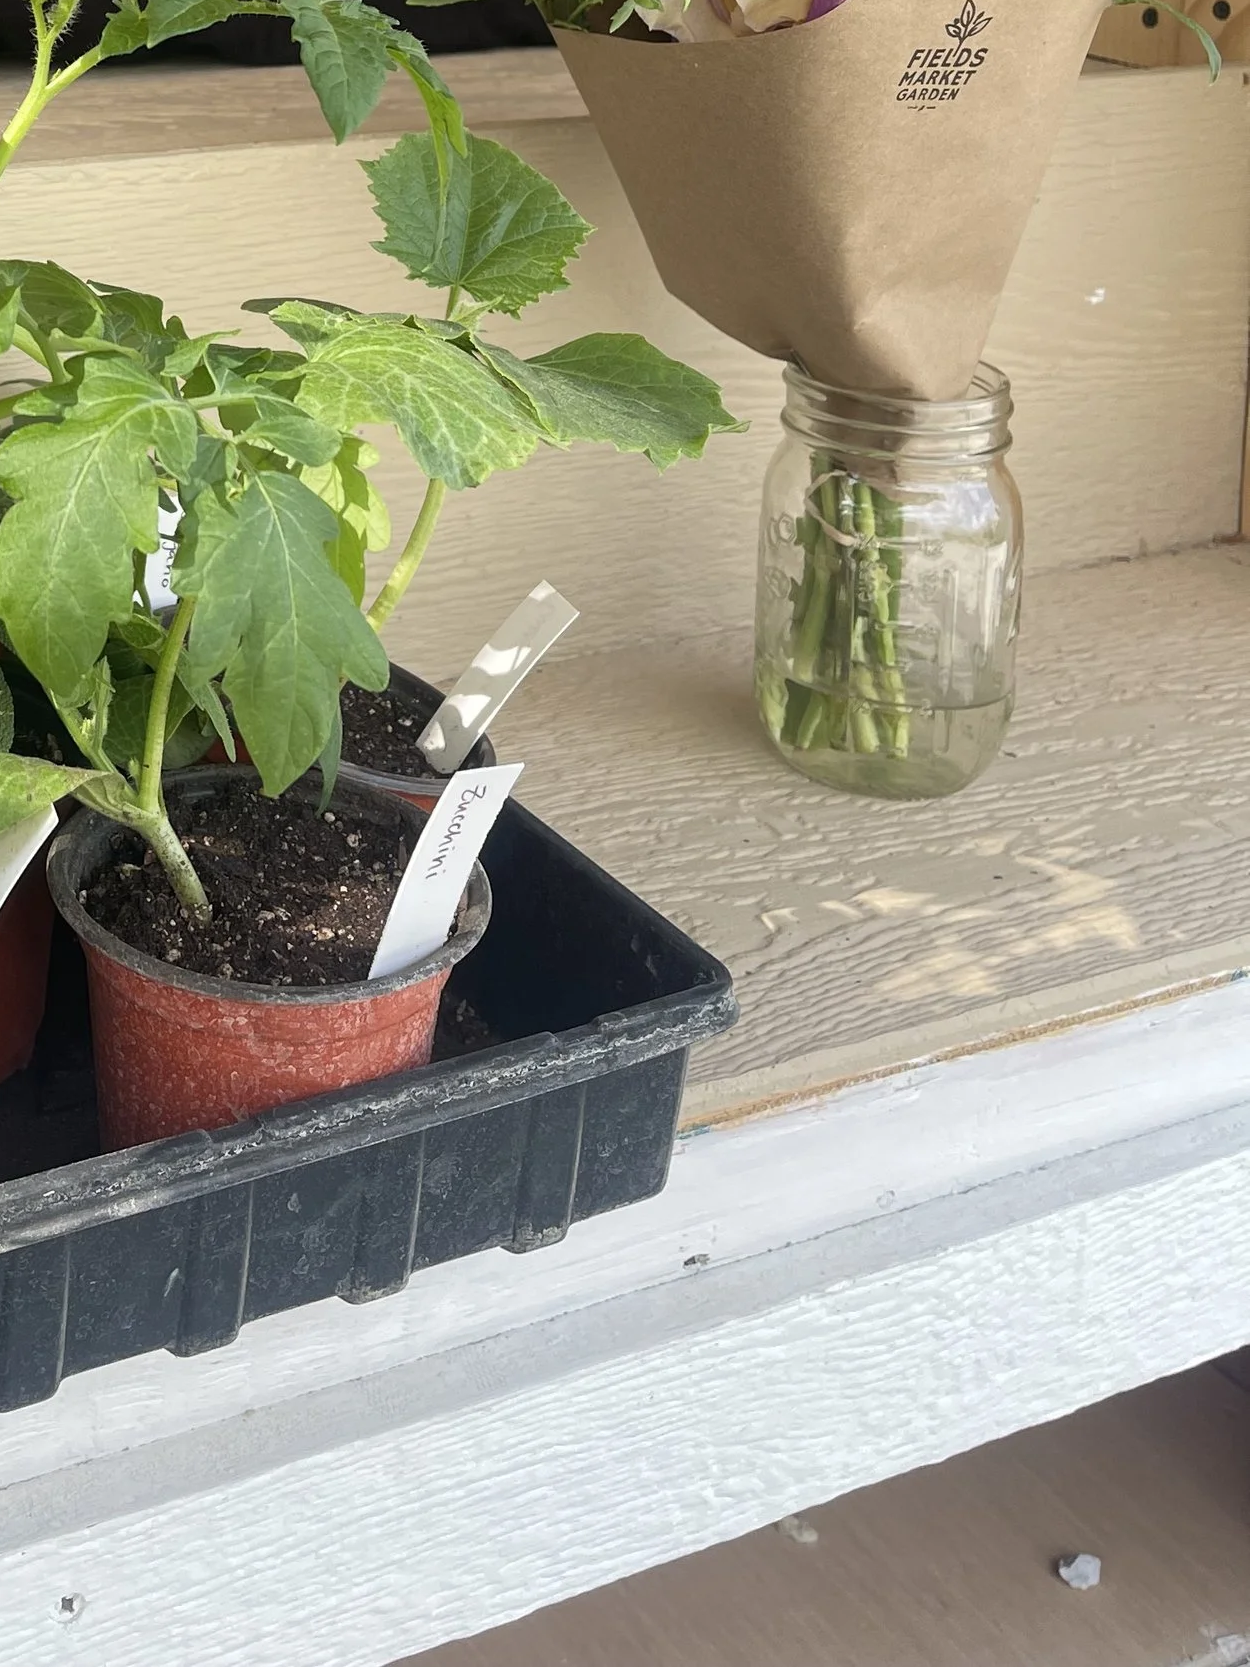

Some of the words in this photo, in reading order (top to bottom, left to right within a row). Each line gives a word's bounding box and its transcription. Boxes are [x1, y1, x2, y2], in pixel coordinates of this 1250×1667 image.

[907, 48, 989, 68] FIELDS
[898, 70, 977, 86] MARKET
[896, 88, 960, 101] GARDEN
[424, 783, 488, 881] Zucchini
